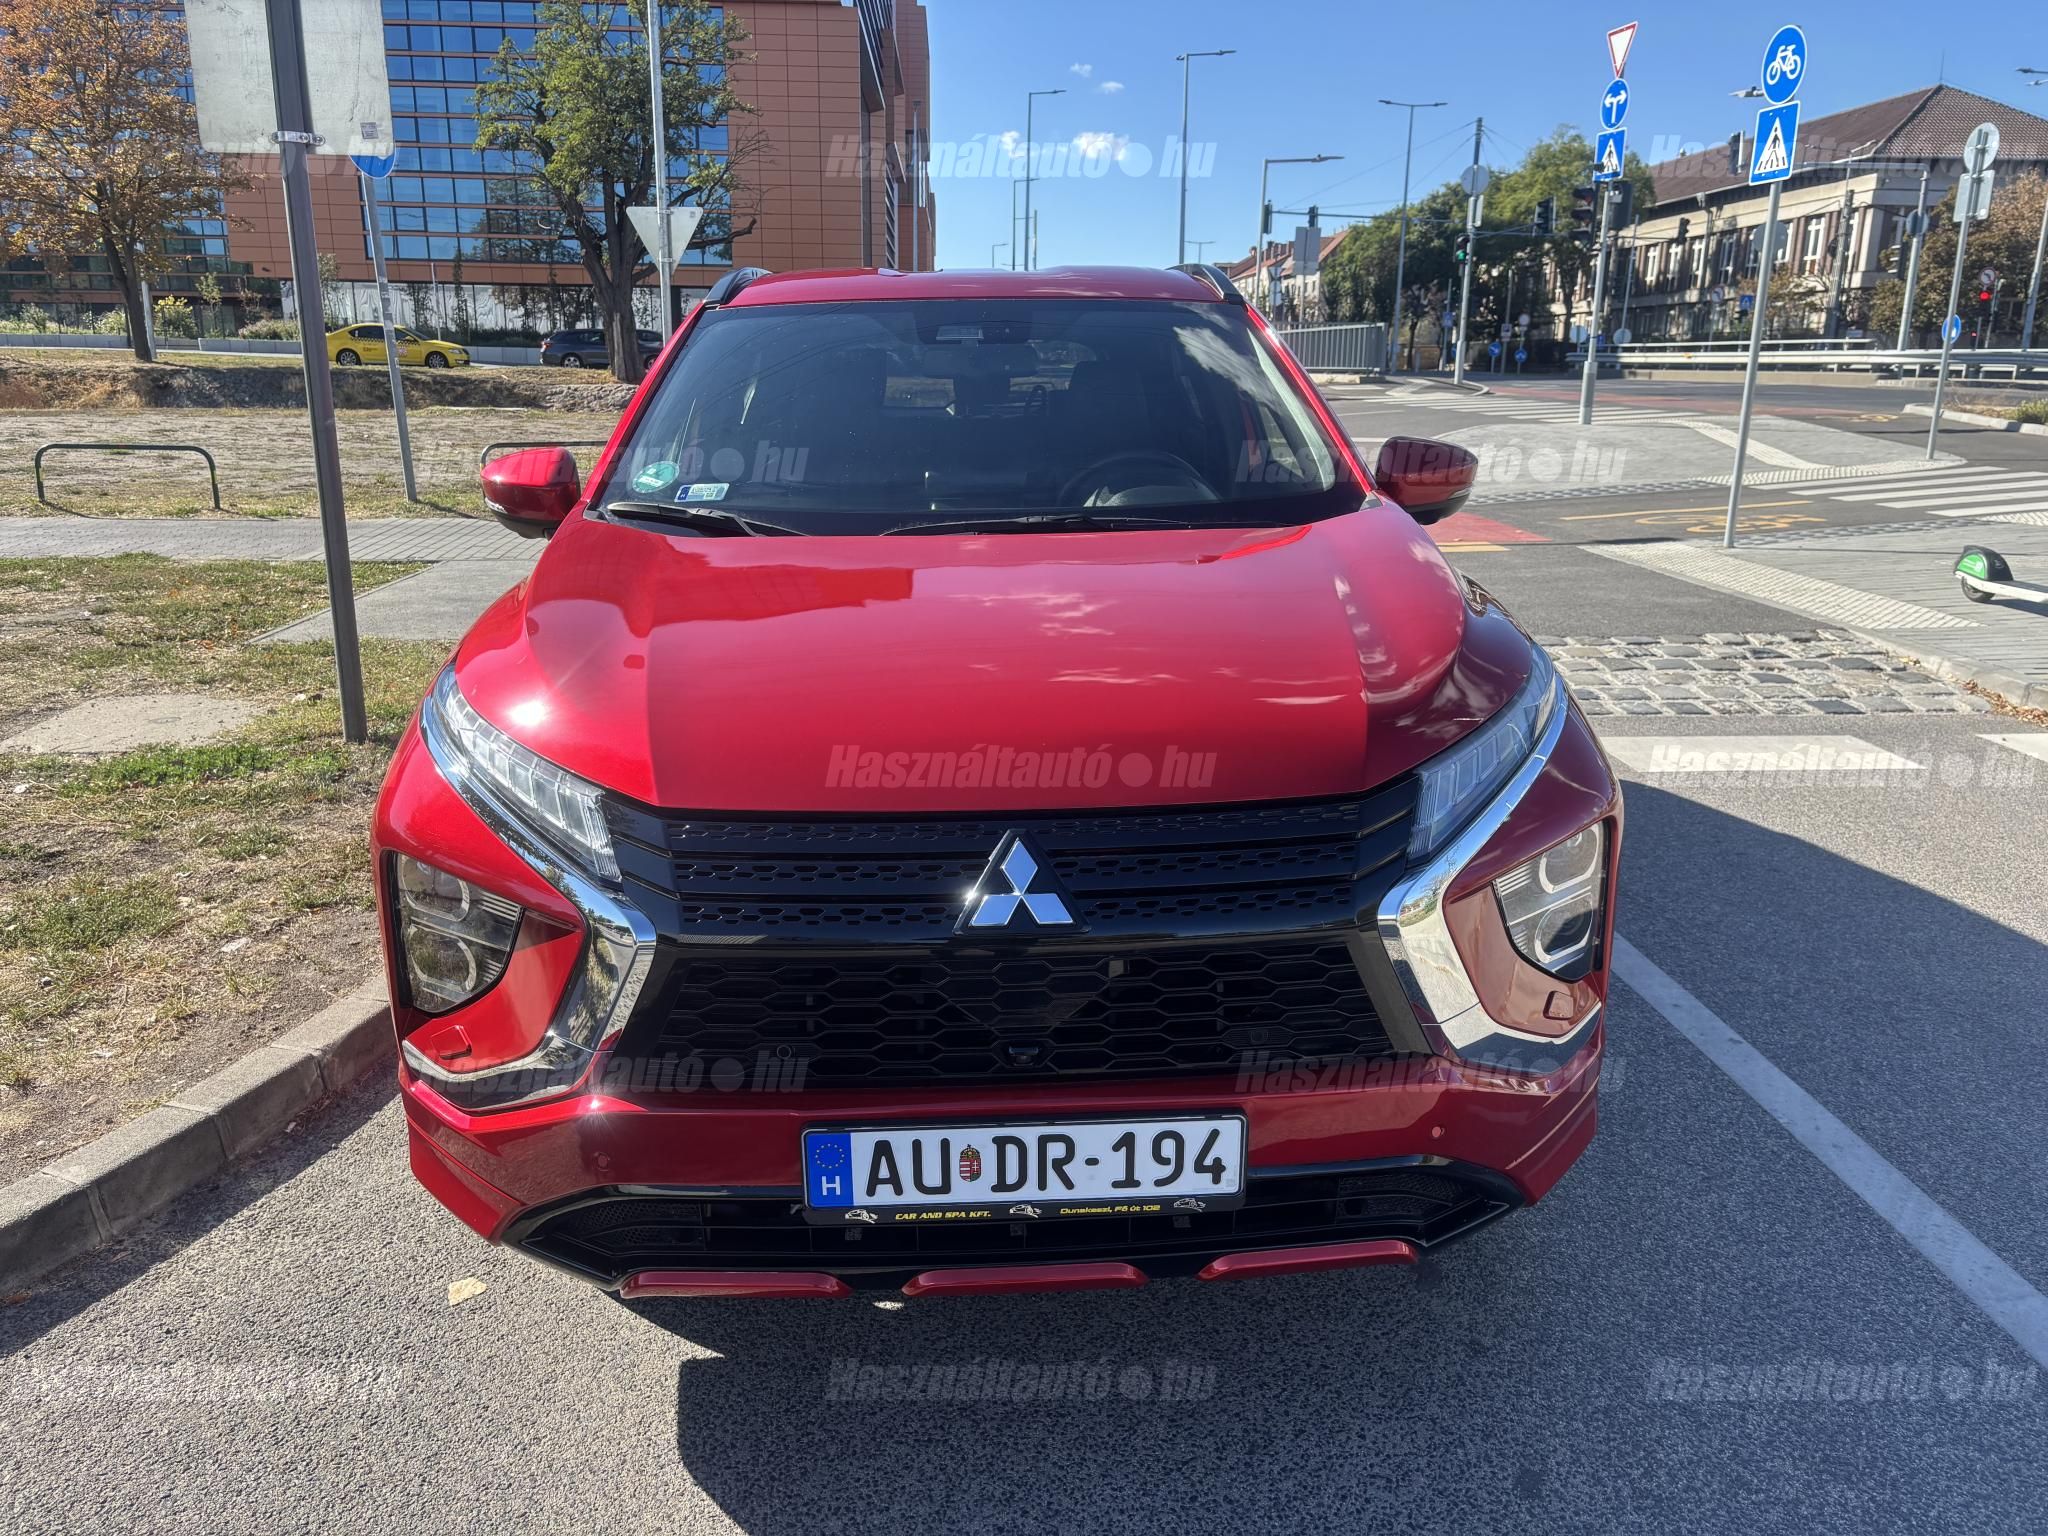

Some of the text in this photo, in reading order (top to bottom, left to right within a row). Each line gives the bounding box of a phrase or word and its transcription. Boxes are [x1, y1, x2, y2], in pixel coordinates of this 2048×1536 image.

[821, 1175, 841, 1196] H
[1142, 1204, 1161, 1212] 102
[919, 1211, 943, 1219] AND
[969, 1210, 992, 1218] KFT.
